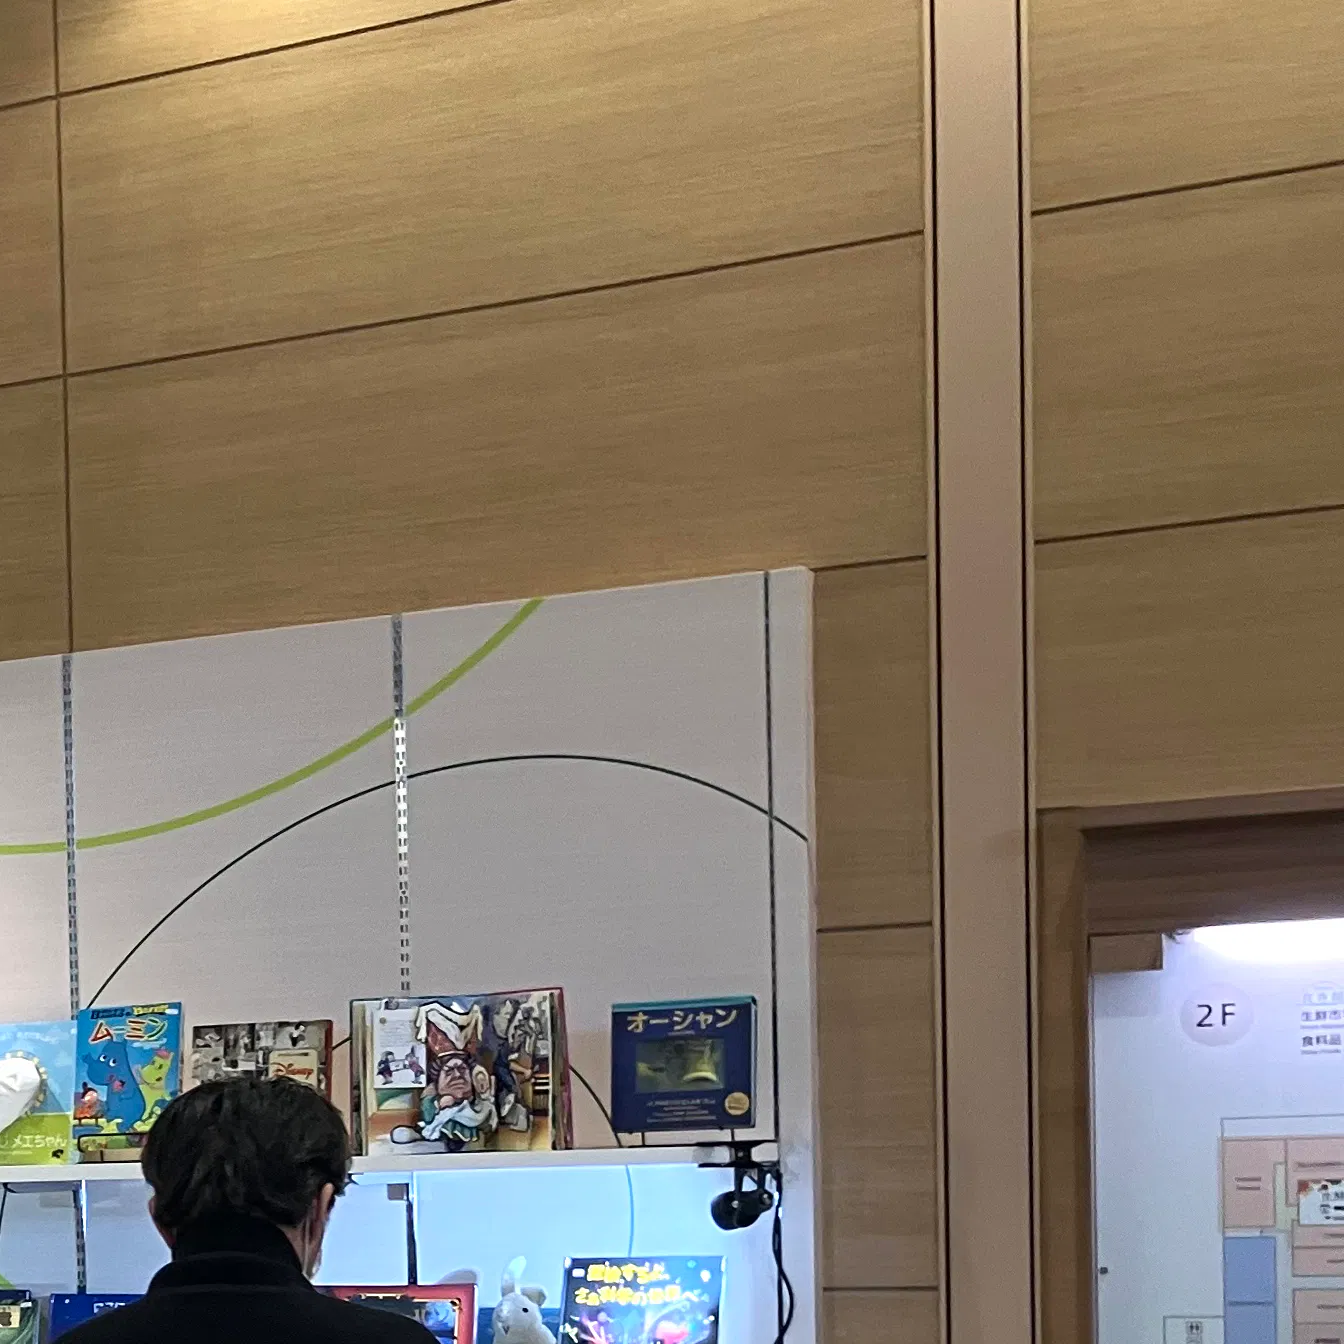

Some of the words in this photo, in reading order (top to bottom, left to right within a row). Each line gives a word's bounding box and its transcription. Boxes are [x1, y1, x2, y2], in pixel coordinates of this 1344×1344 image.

[627, 1008, 737, 1033] オーシャン
[1197, 1002, 1237, 1028] 2F
[89, 1017, 168, 1044] ムーミン
